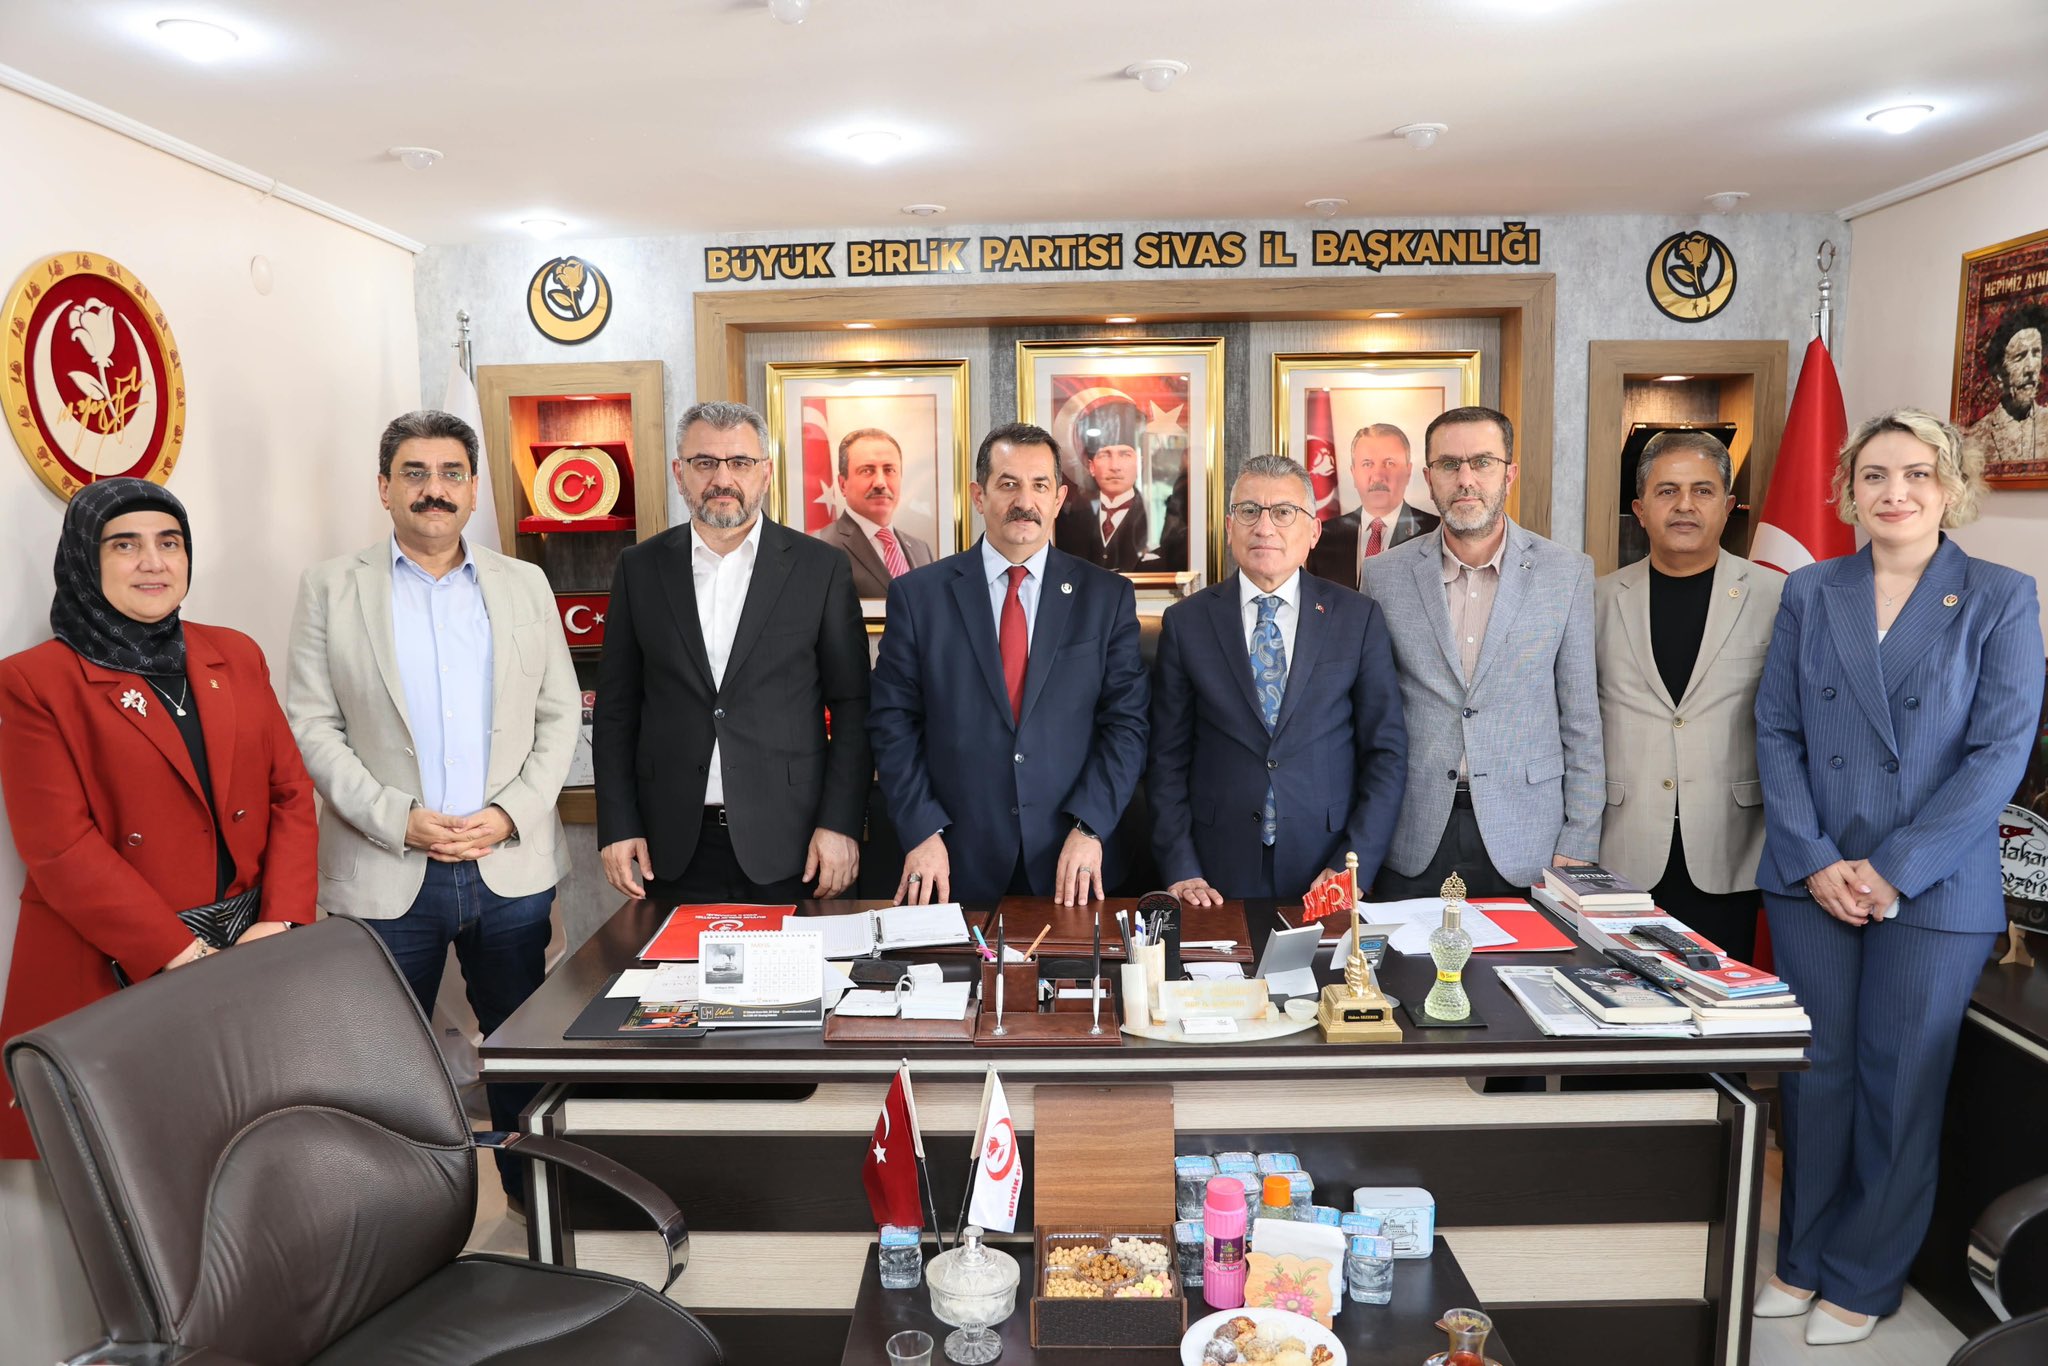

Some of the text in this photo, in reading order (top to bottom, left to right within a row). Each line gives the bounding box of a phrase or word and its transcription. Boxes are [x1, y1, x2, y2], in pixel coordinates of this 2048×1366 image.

[706, 222, 1540, 282] BÜYÜK BİRLİK PARTİSİ SİVAS İL BAŞKANLIĞI
